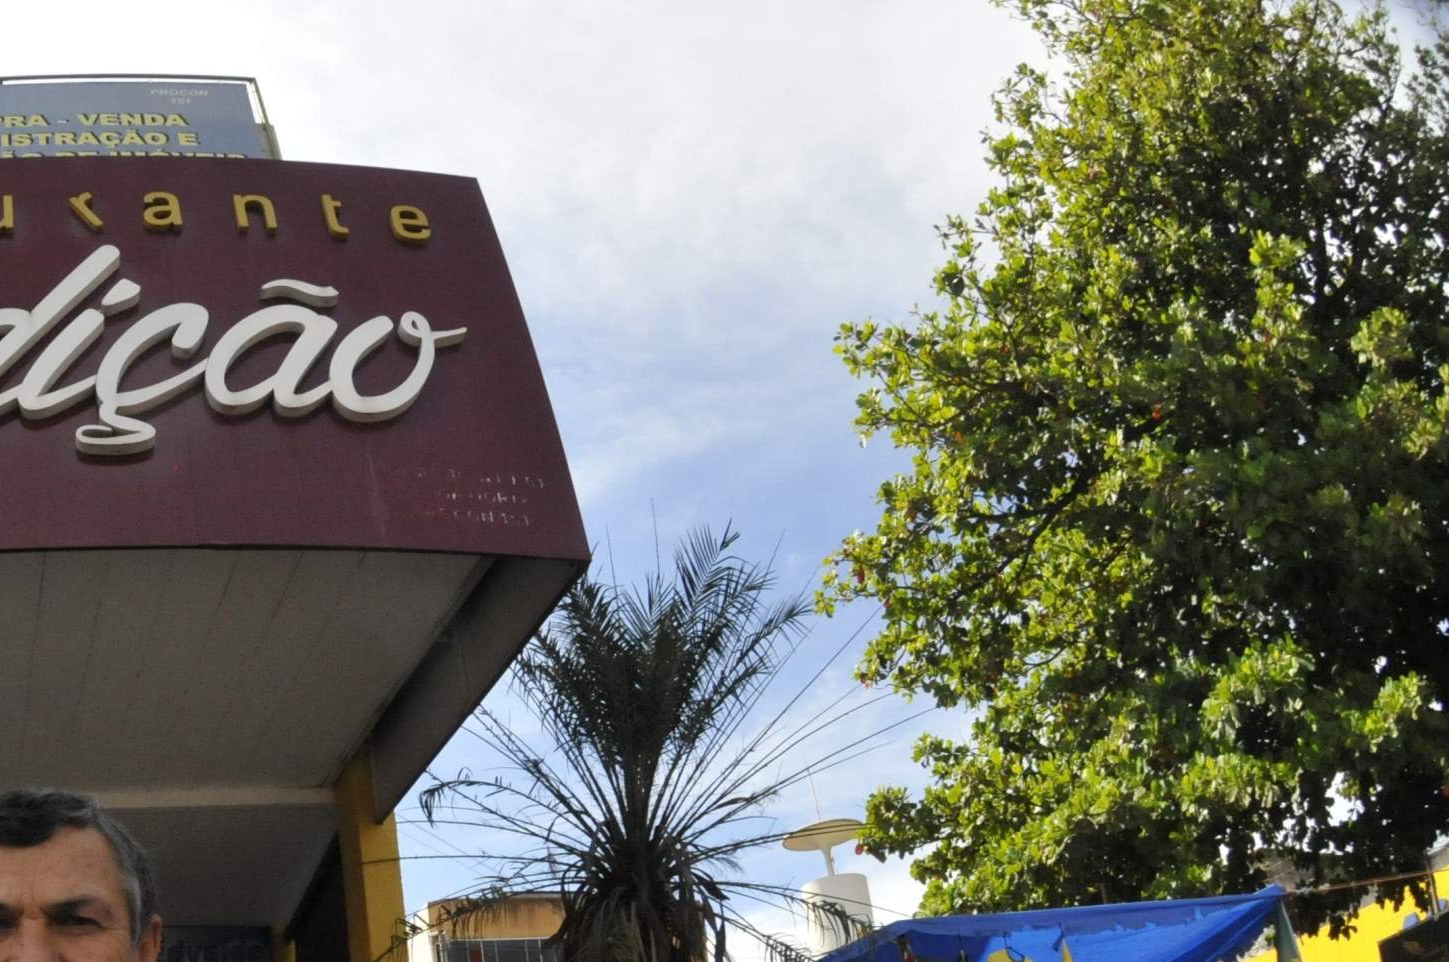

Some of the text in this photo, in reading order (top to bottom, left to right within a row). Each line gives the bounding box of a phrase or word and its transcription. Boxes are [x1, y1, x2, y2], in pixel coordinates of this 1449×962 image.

[150, 88, 209, 97] PROCON
[76, 112, 190, 128] VENDA
[177, 130, 200, 147] E
